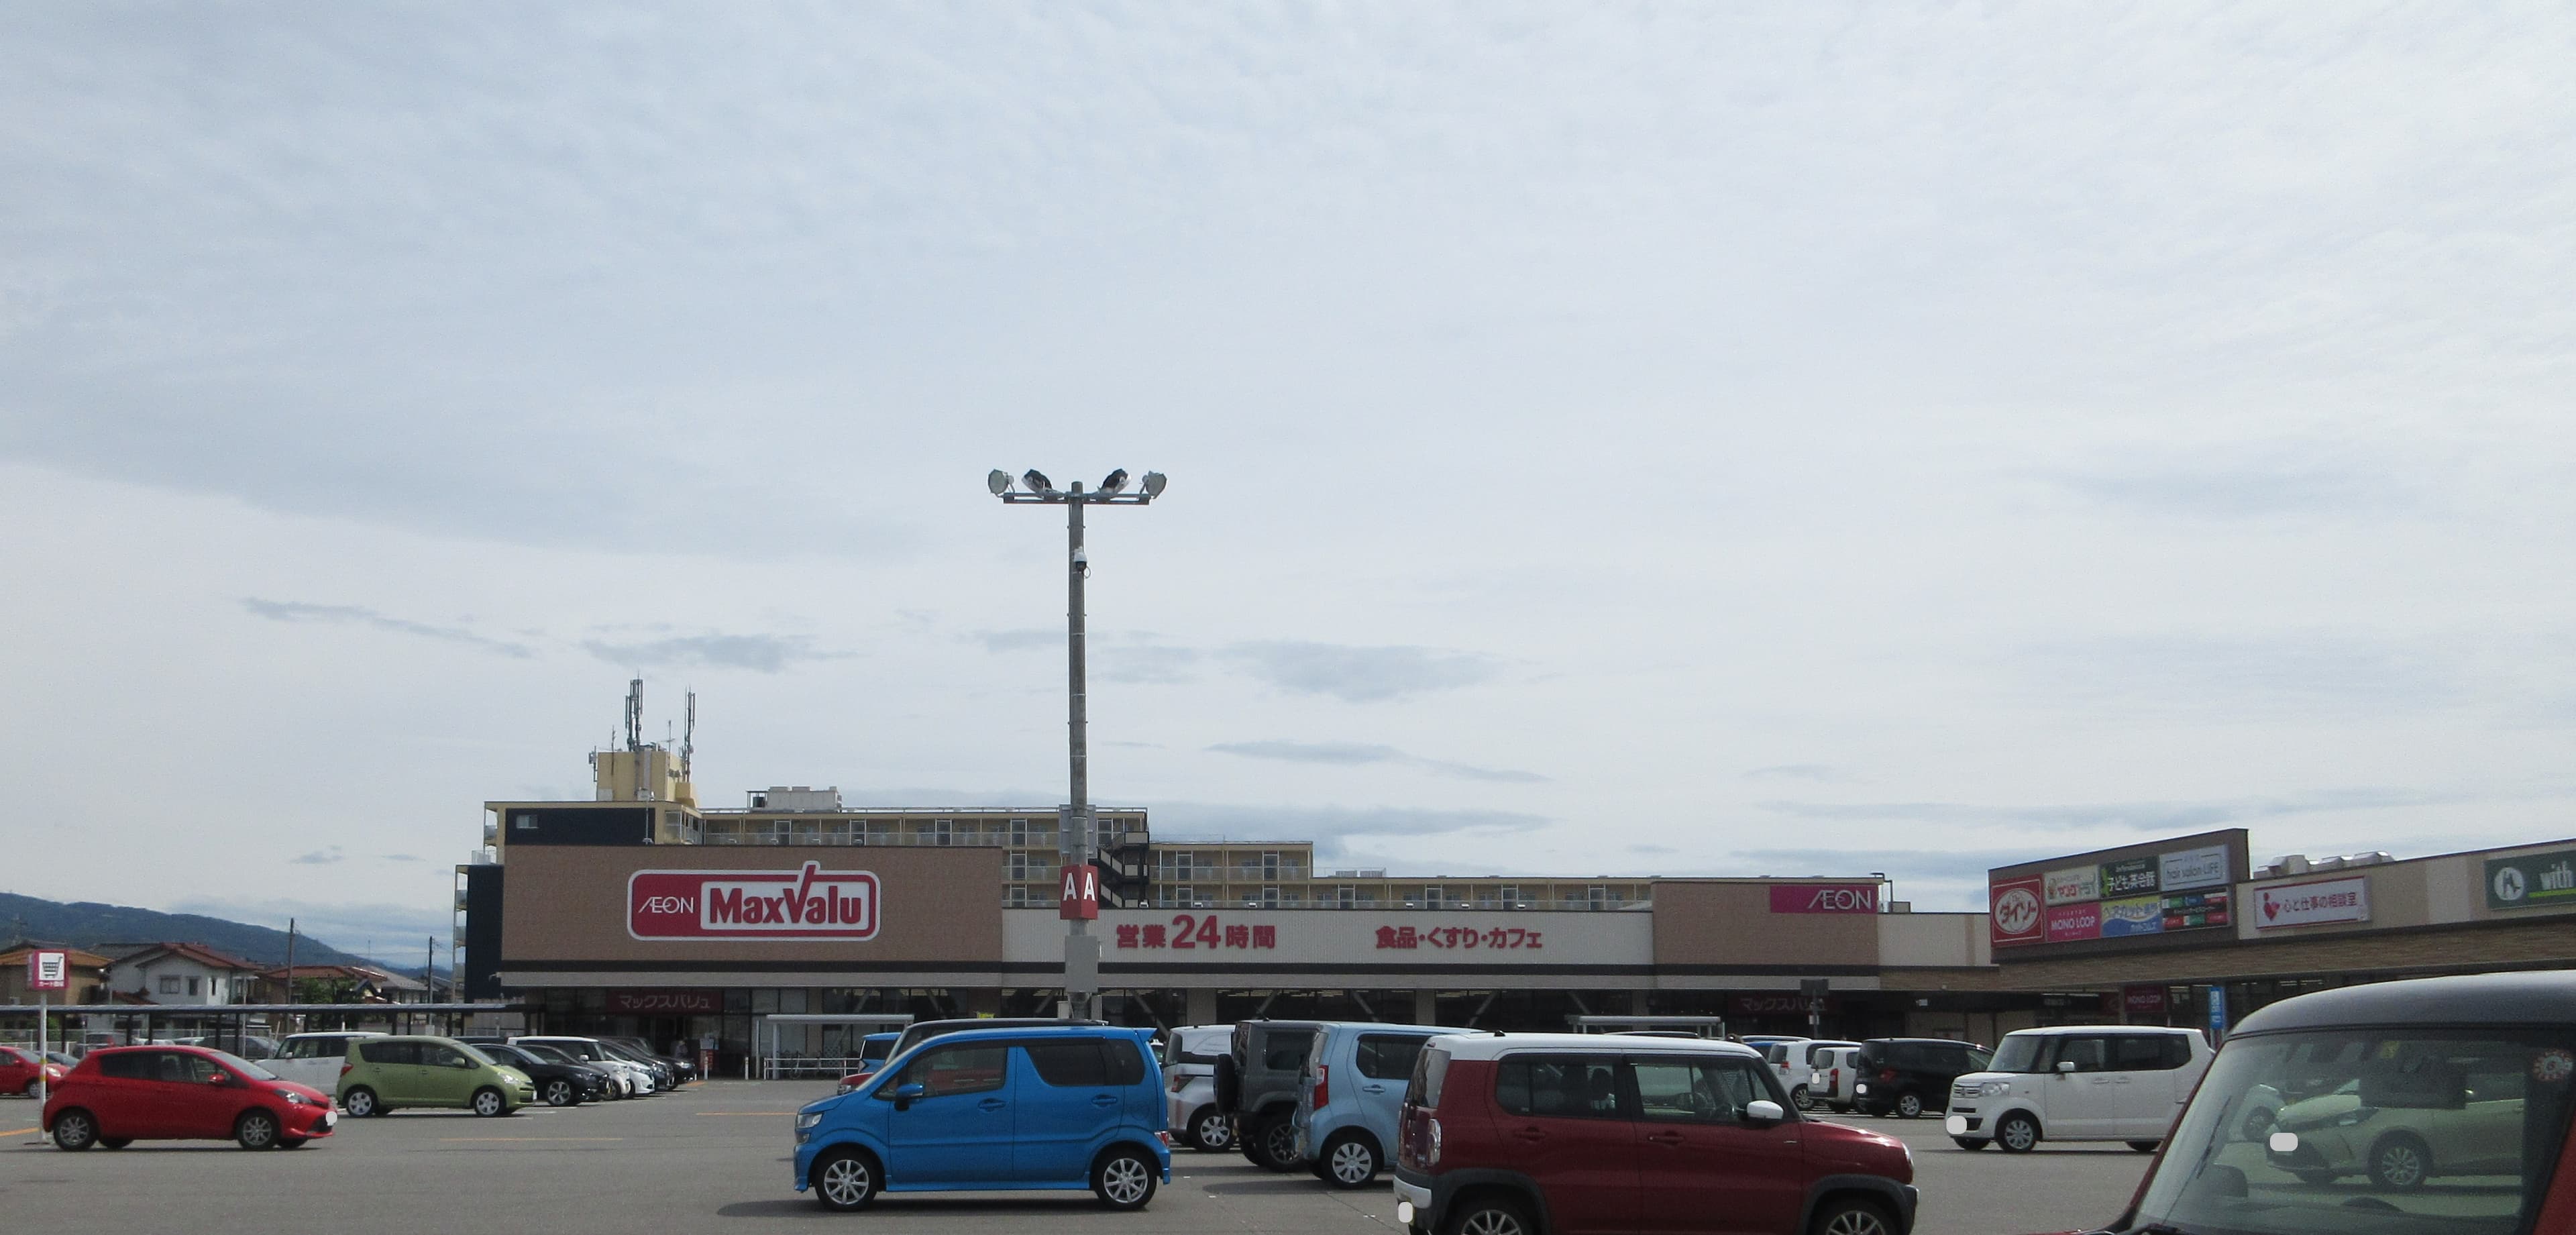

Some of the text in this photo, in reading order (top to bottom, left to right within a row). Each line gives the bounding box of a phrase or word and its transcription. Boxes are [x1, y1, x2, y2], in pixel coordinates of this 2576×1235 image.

[1063, 872, 1077, 901] A
[1083, 872, 1095, 901] A
[2539, 861, 2574, 891] with
[710, 865, 861, 924] MaxValu
[2284, 892, 2357, 913] 心と仕事の相談室
[2051, 916, 2095, 931] MONO LOOP
[619, 994, 711, 1010] マックスバリュ
